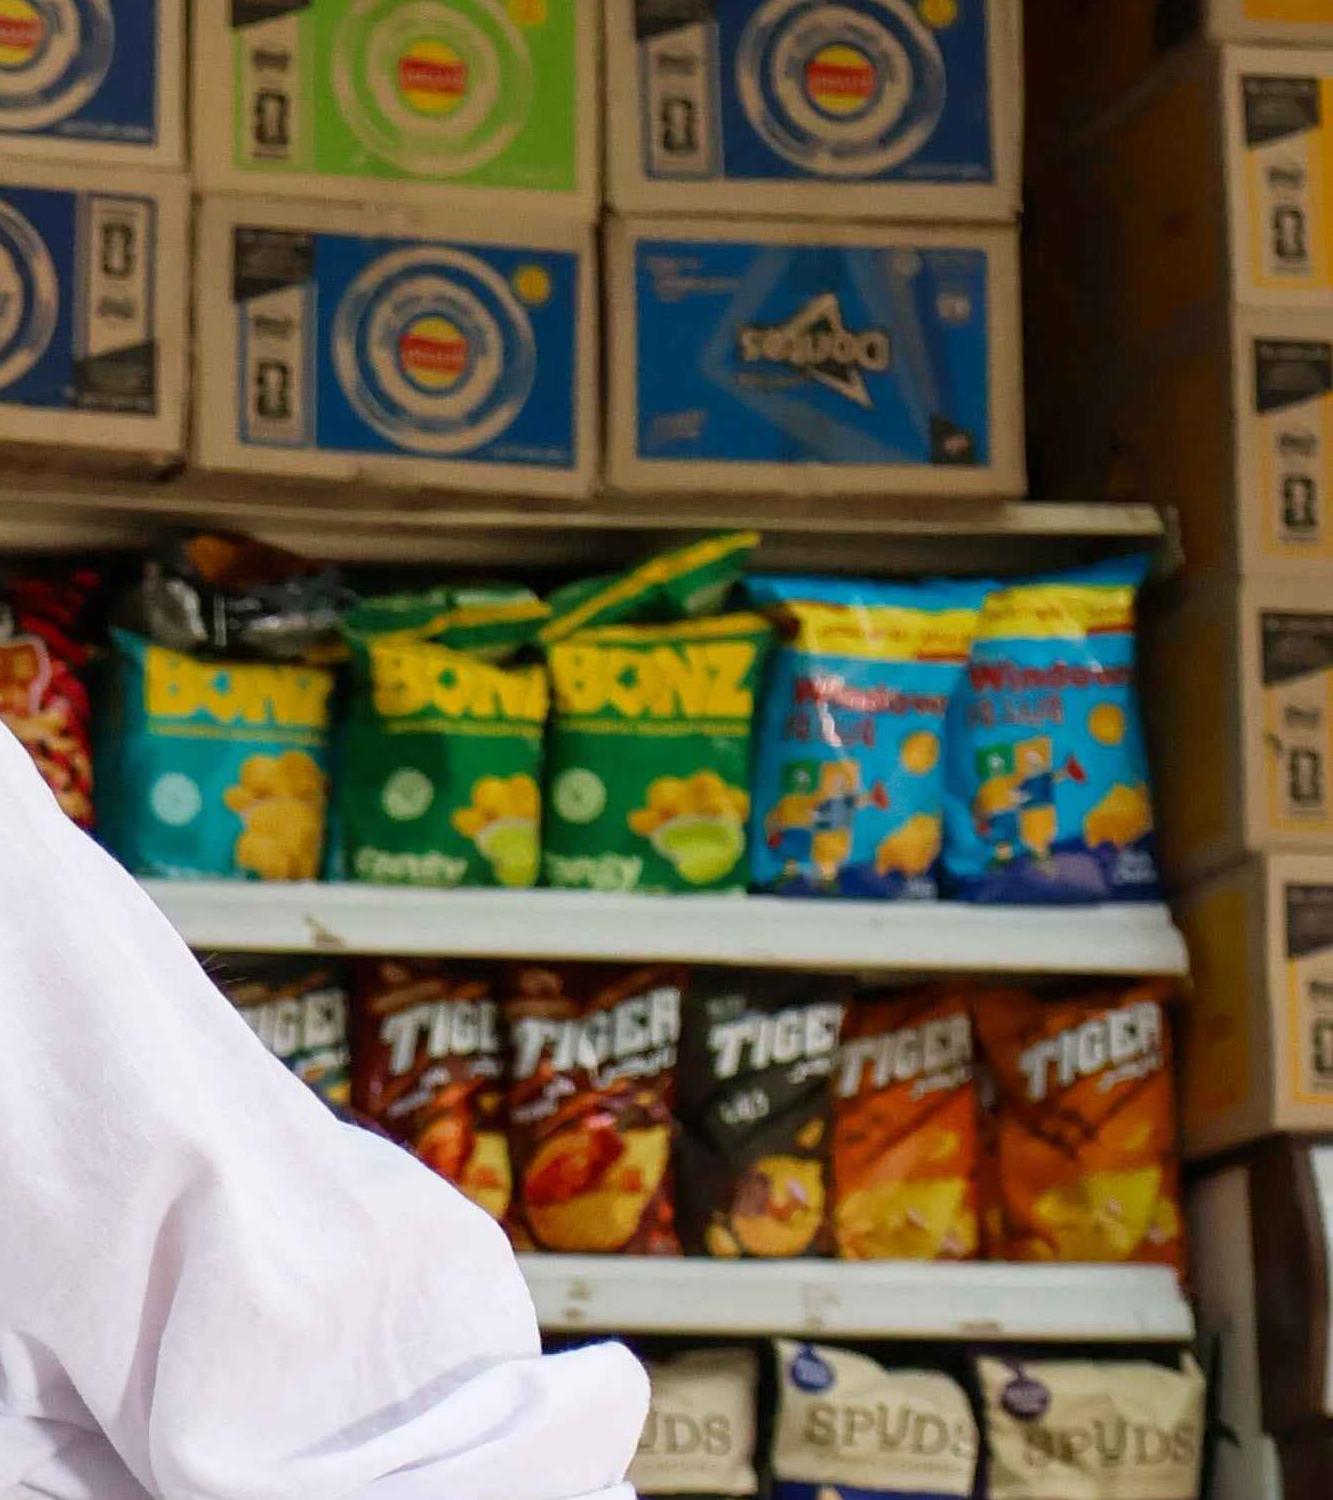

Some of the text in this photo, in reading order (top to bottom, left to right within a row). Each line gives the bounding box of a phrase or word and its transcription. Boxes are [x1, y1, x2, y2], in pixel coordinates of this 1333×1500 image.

[549, 642, 756, 718] BONZ
[515, 986, 682, 1080] TIGER
[1021, 1001, 1163, 1102] TIGER
